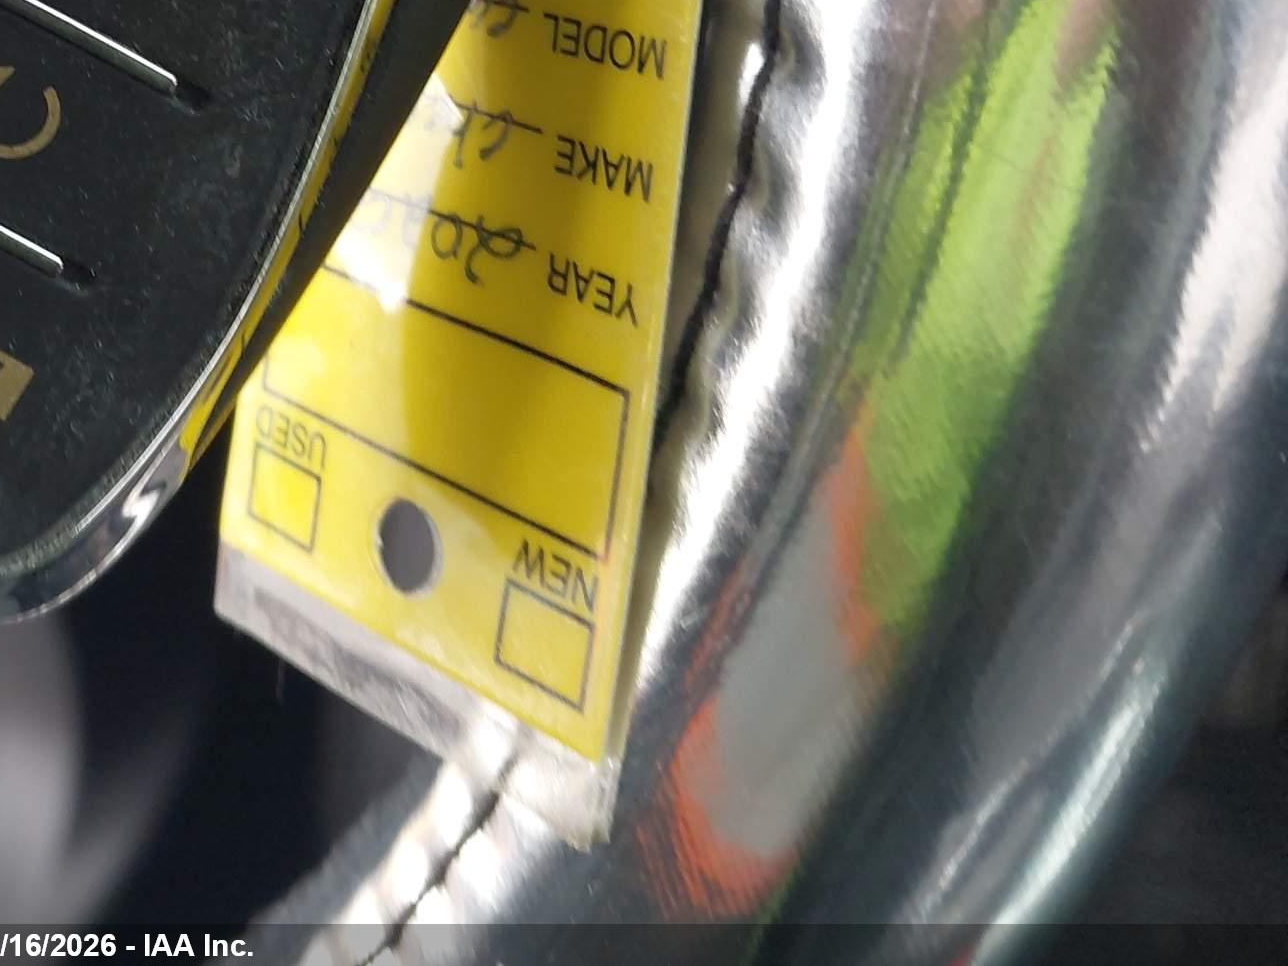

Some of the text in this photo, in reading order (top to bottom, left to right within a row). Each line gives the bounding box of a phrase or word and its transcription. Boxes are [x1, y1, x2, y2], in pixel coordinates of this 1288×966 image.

[543, 12, 668, 80] MODEL
[555, 134, 654, 203] MAKE
[547, 252, 639, 327] YEAR
[255, 405, 328, 468] USED
[514, 539, 598, 613] NEW
